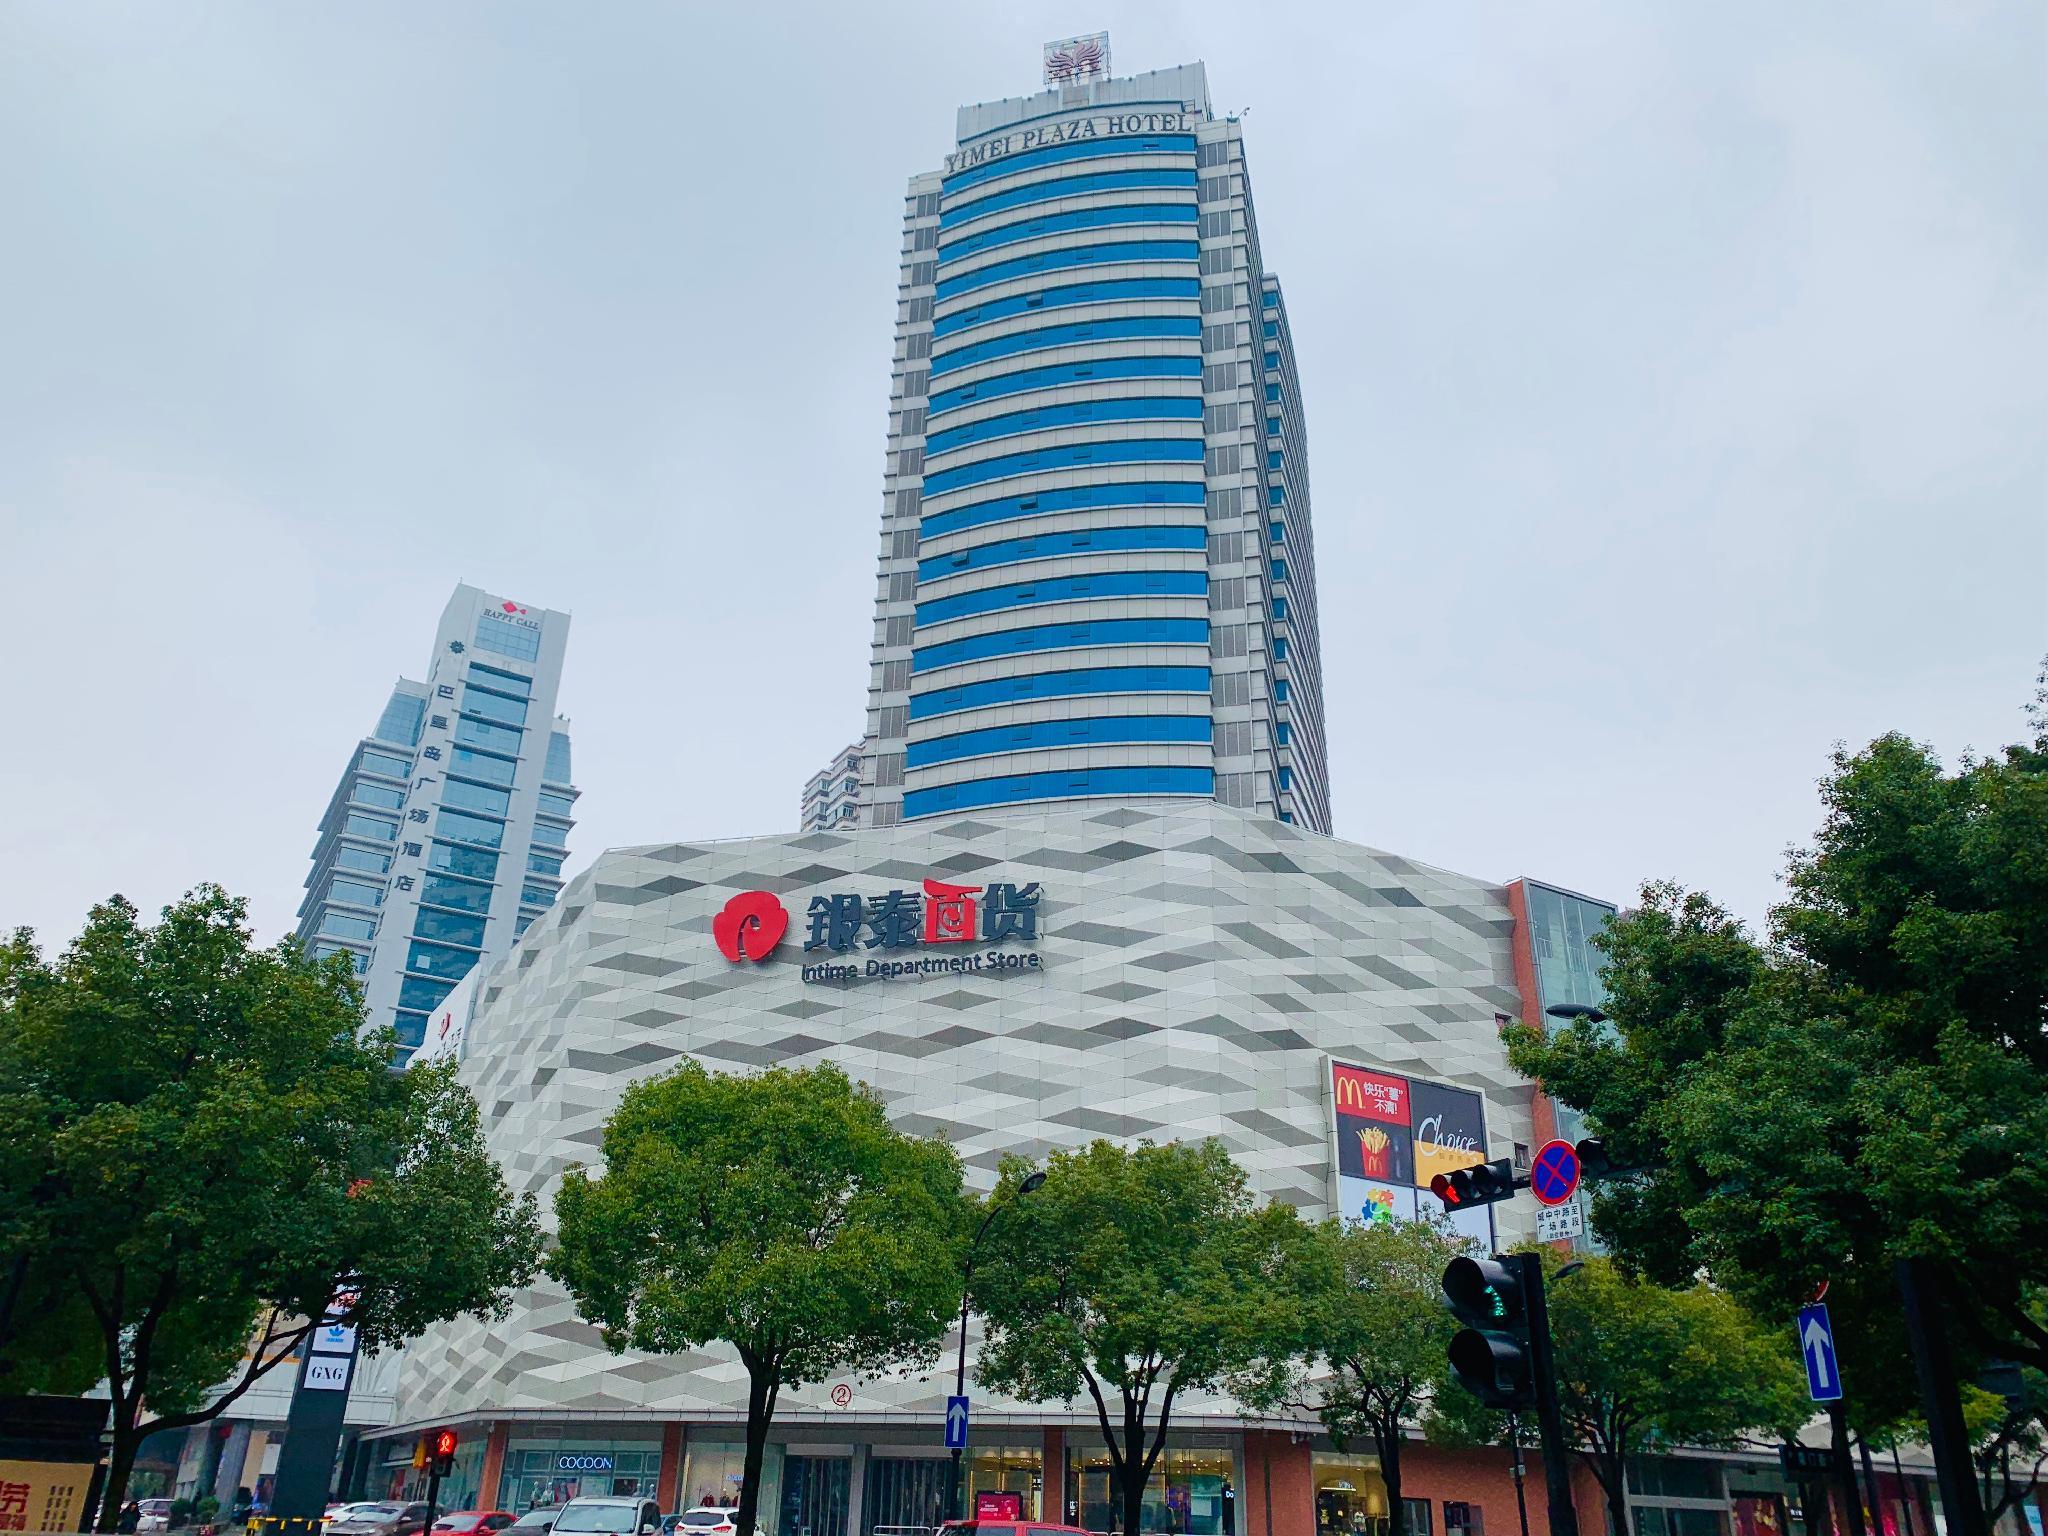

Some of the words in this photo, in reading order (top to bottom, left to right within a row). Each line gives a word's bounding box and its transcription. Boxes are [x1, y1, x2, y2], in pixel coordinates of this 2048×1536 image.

[945, 136, 1011, 174] YIMEI
[1022, 119, 1096, 149] PLAZA
[1107, 113, 1192, 135] HOTEL
[483, 608, 515, 623] HAPPY
[516, 617, 539, 630] CALL
[801, 962, 858, 983] Intime
[866, 952, 981, 979] Department
[986, 950, 1039, 970] Store
[1418, 1114, 1478, 1157] Choice
[311, 1366, 343, 1380] GXG
[559, 1456, 613, 1469] COCOON
